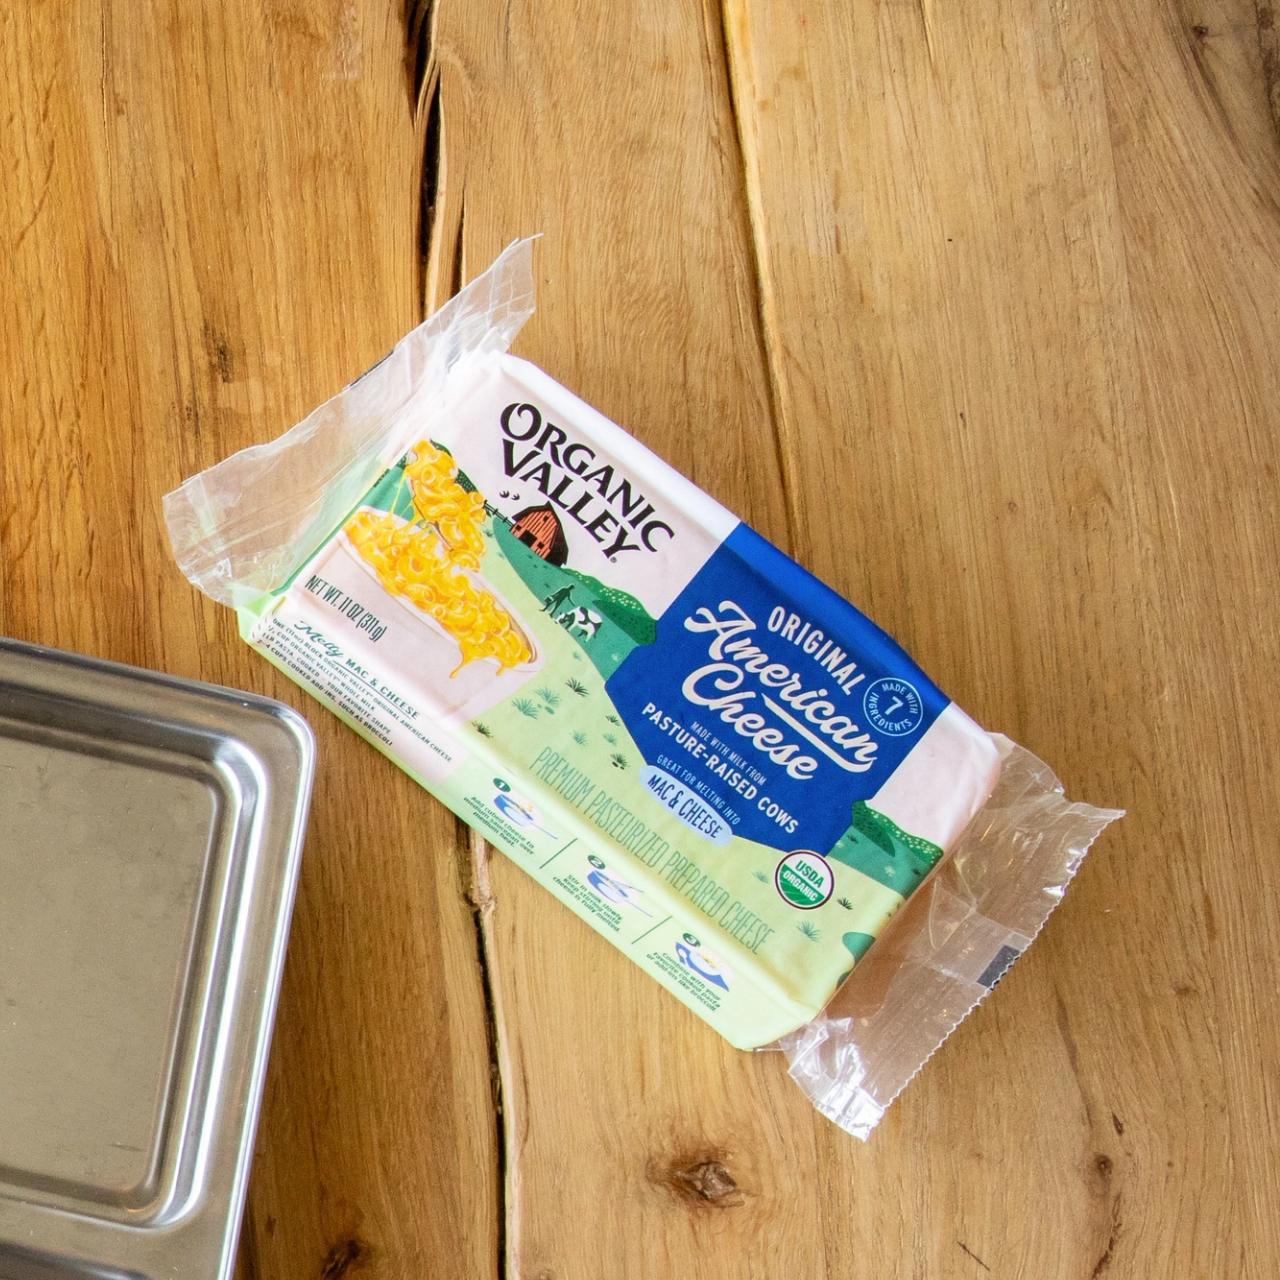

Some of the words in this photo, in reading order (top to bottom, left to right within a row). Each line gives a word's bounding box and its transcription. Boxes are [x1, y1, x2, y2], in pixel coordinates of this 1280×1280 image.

[501, 401, 676, 552] ORGANIC
[304, 574, 328, 596] NET
[321, 585, 344, 607] WT.
[337, 596, 353, 613] 11
[345, 602, 364, 622] OZ
[355, 611, 388, 643] (311g)
[276, 631, 290, 644] CUP
[289, 641, 315, 664] ORGANIC
[339, 681, 360, 699] WHOLE
[769, 605, 865, 696] ORIGINAL
[269, 647, 287, 663] CUPS
[286, 660, 311, 681] COOKED
[337, 701, 354, 716] SUCH
[353, 714, 364, 724] AS
[362, 721, 393, 746] BROCCOLI
[295, 657, 320, 678] COOKED
[325, 681, 344, 697] YOUR
[342, 694, 371, 719] FAVORITE
[302, 641, 323, 659] BLOCK
[322, 657, 349, 680] ORGANIC
[372, 697, 400, 721] ORIGINAL
[399, 718, 430, 745] AMERICAN
[428, 742, 452, 762] CHEESE
[344, 657, 369, 679] MAC
[369, 677, 378, 687] &
[379, 685, 420, 720] CHEESE
[683, 601, 876, 772] American
[683, 662, 817, 778] Cheese
[868, 691, 913, 730] INGREDIENTS
[881, 684, 906, 695] MADE
[905, 691, 916, 715] WITH
[881, 695, 903, 718] 7
[640, 701, 759, 802] PASTURE-RAISED
[755, 794, 799, 835] COWS
[689, 721, 712, 743] MADE
[708, 737, 730, 757] WITH
[726, 751, 748, 771] MILK
[744, 766, 767, 787] FROM
[645, 772, 675, 802] MAC
[667, 790, 684, 808] &
[676, 797, 724, 839] CHEESE
[654, 754, 682, 775] GREAT
[678, 769, 697, 787] FOR
[692, 780, 726, 812] MELTING
[721, 804, 741, 827] INTO
[528, 745, 596, 809] PREMIUM
[583, 789, 670, 870] PASTEURIZED
[656, 850, 731, 920] PREPARED
[719, 901, 775, 956] CHEESE
[793, 859, 825, 888] USDA
[781, 869, 819, 902] ORGANIC
